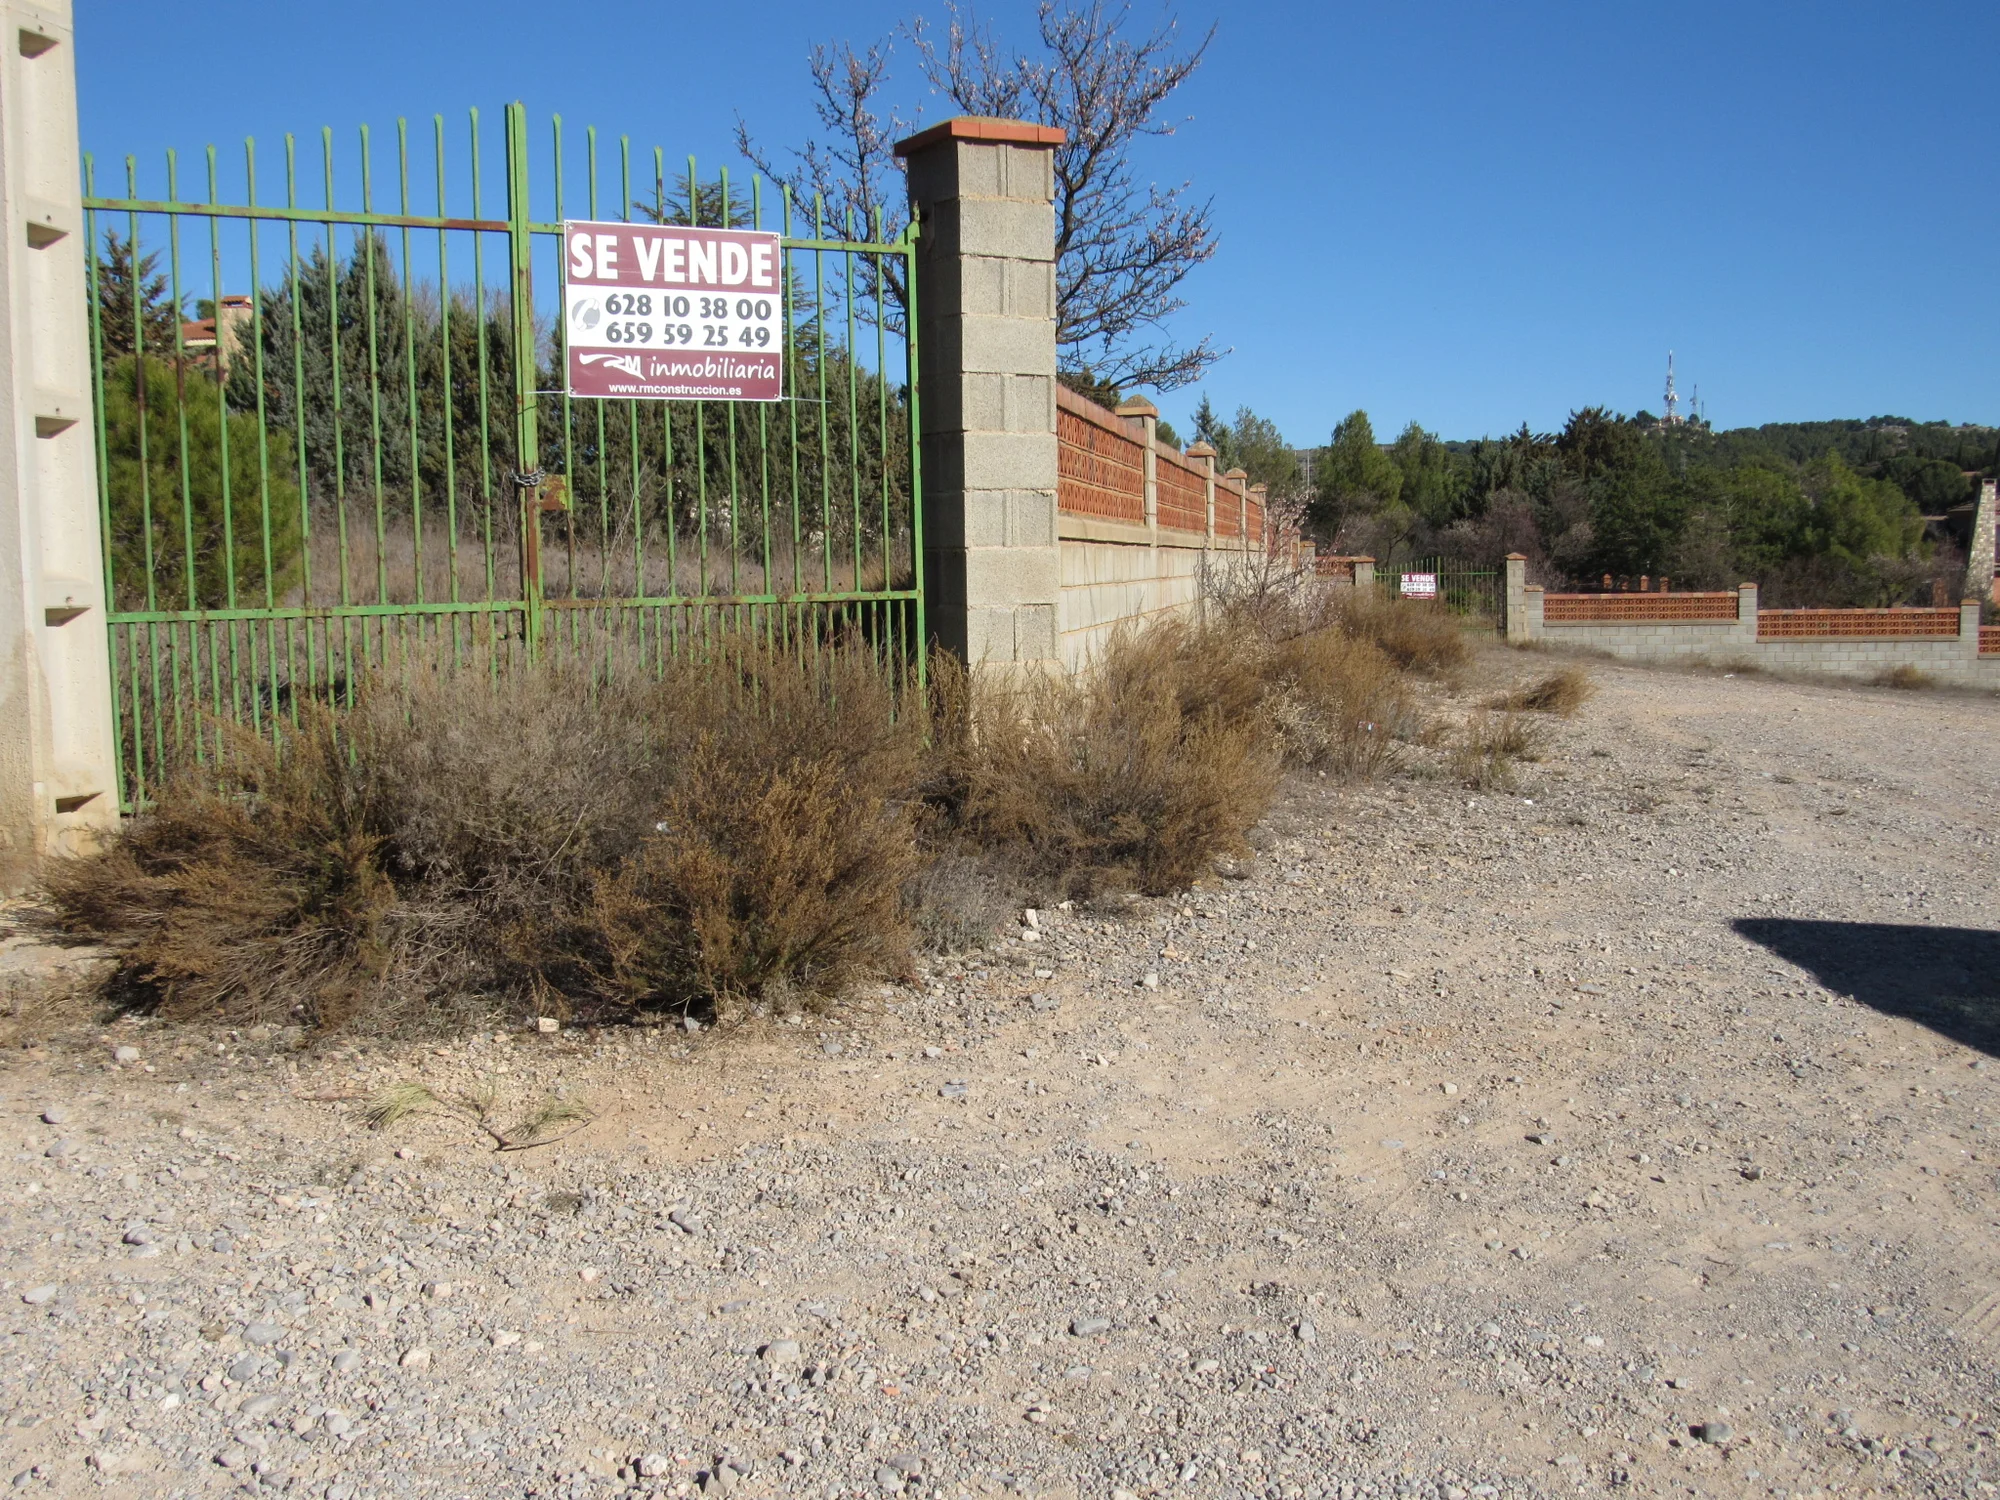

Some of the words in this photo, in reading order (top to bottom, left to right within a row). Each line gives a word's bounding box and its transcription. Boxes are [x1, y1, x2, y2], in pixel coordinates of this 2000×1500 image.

[570, 232, 619, 280] SE
[632, 236, 773, 287] VENDE
[605, 293, 652, 316] 628
[664, 295, 690, 318] 10
[700, 297, 728, 319] 38
[736, 298, 772, 321] 00
[606, 321, 653, 344] 659
[663, 323, 693, 345] 59
[703, 325, 729, 346] 25
[738, 326, 770, 348] 49
[650, 356, 775, 380] inmobiliaria
[608, 383, 742, 396] www.rmconstruccion.es
